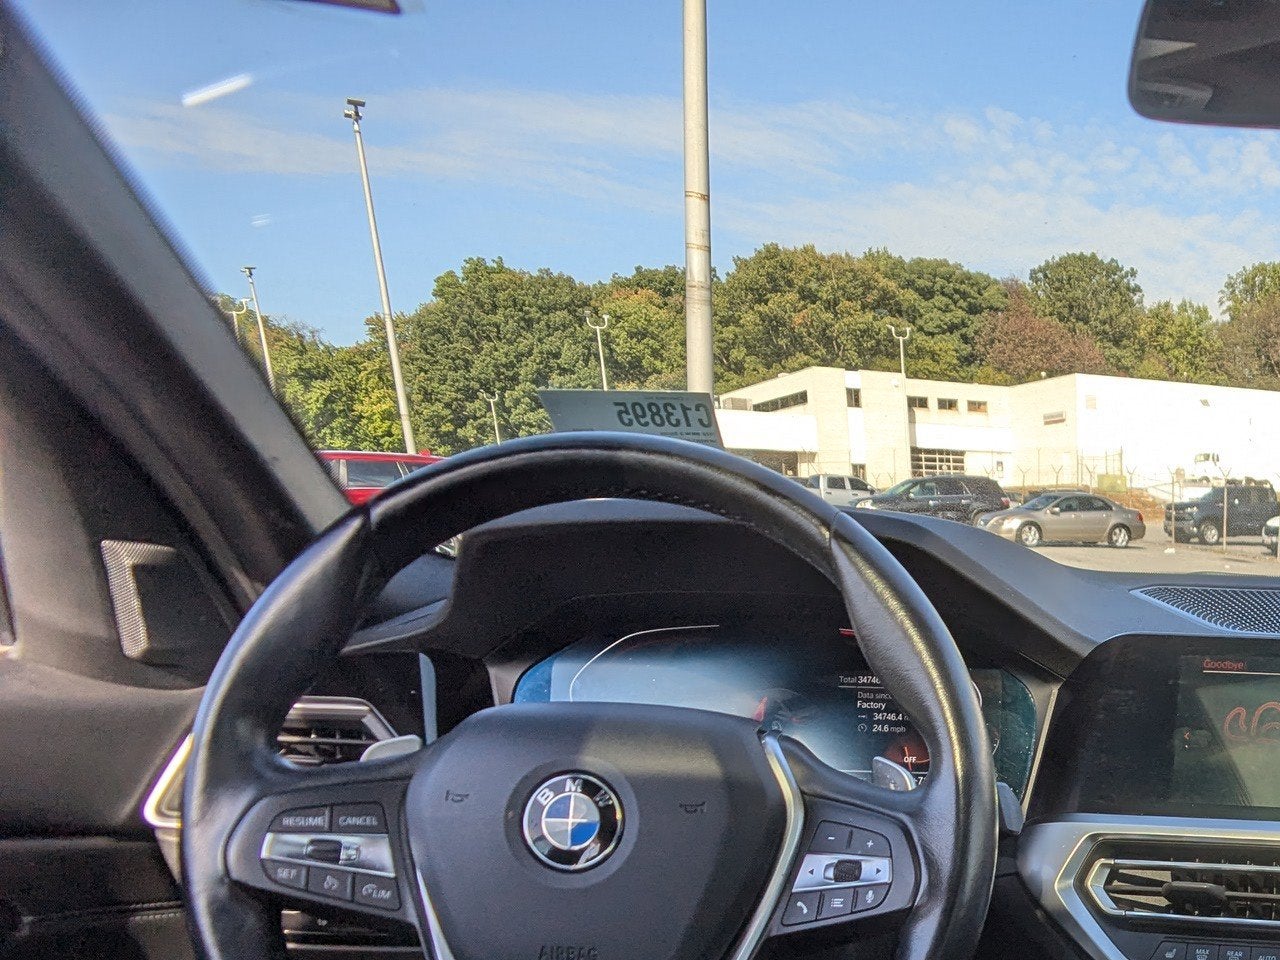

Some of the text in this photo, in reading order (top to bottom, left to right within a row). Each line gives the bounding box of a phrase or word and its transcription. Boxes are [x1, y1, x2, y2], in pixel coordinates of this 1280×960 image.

[839, 675, 857, 684] Total
[857, 691, 874, 699] Data
[857, 700, 886, 710] Factory
[873, 712, 903, 721] 34746.4
[872, 724, 889, 732] 24.6
[536, 778, 613, 808] BMW
[282, 817, 326, 826] RESUME
[338, 817, 378, 826] CANCEL
[276, 868, 297, 879] SET
[371, 888, 392, 899] LIM
